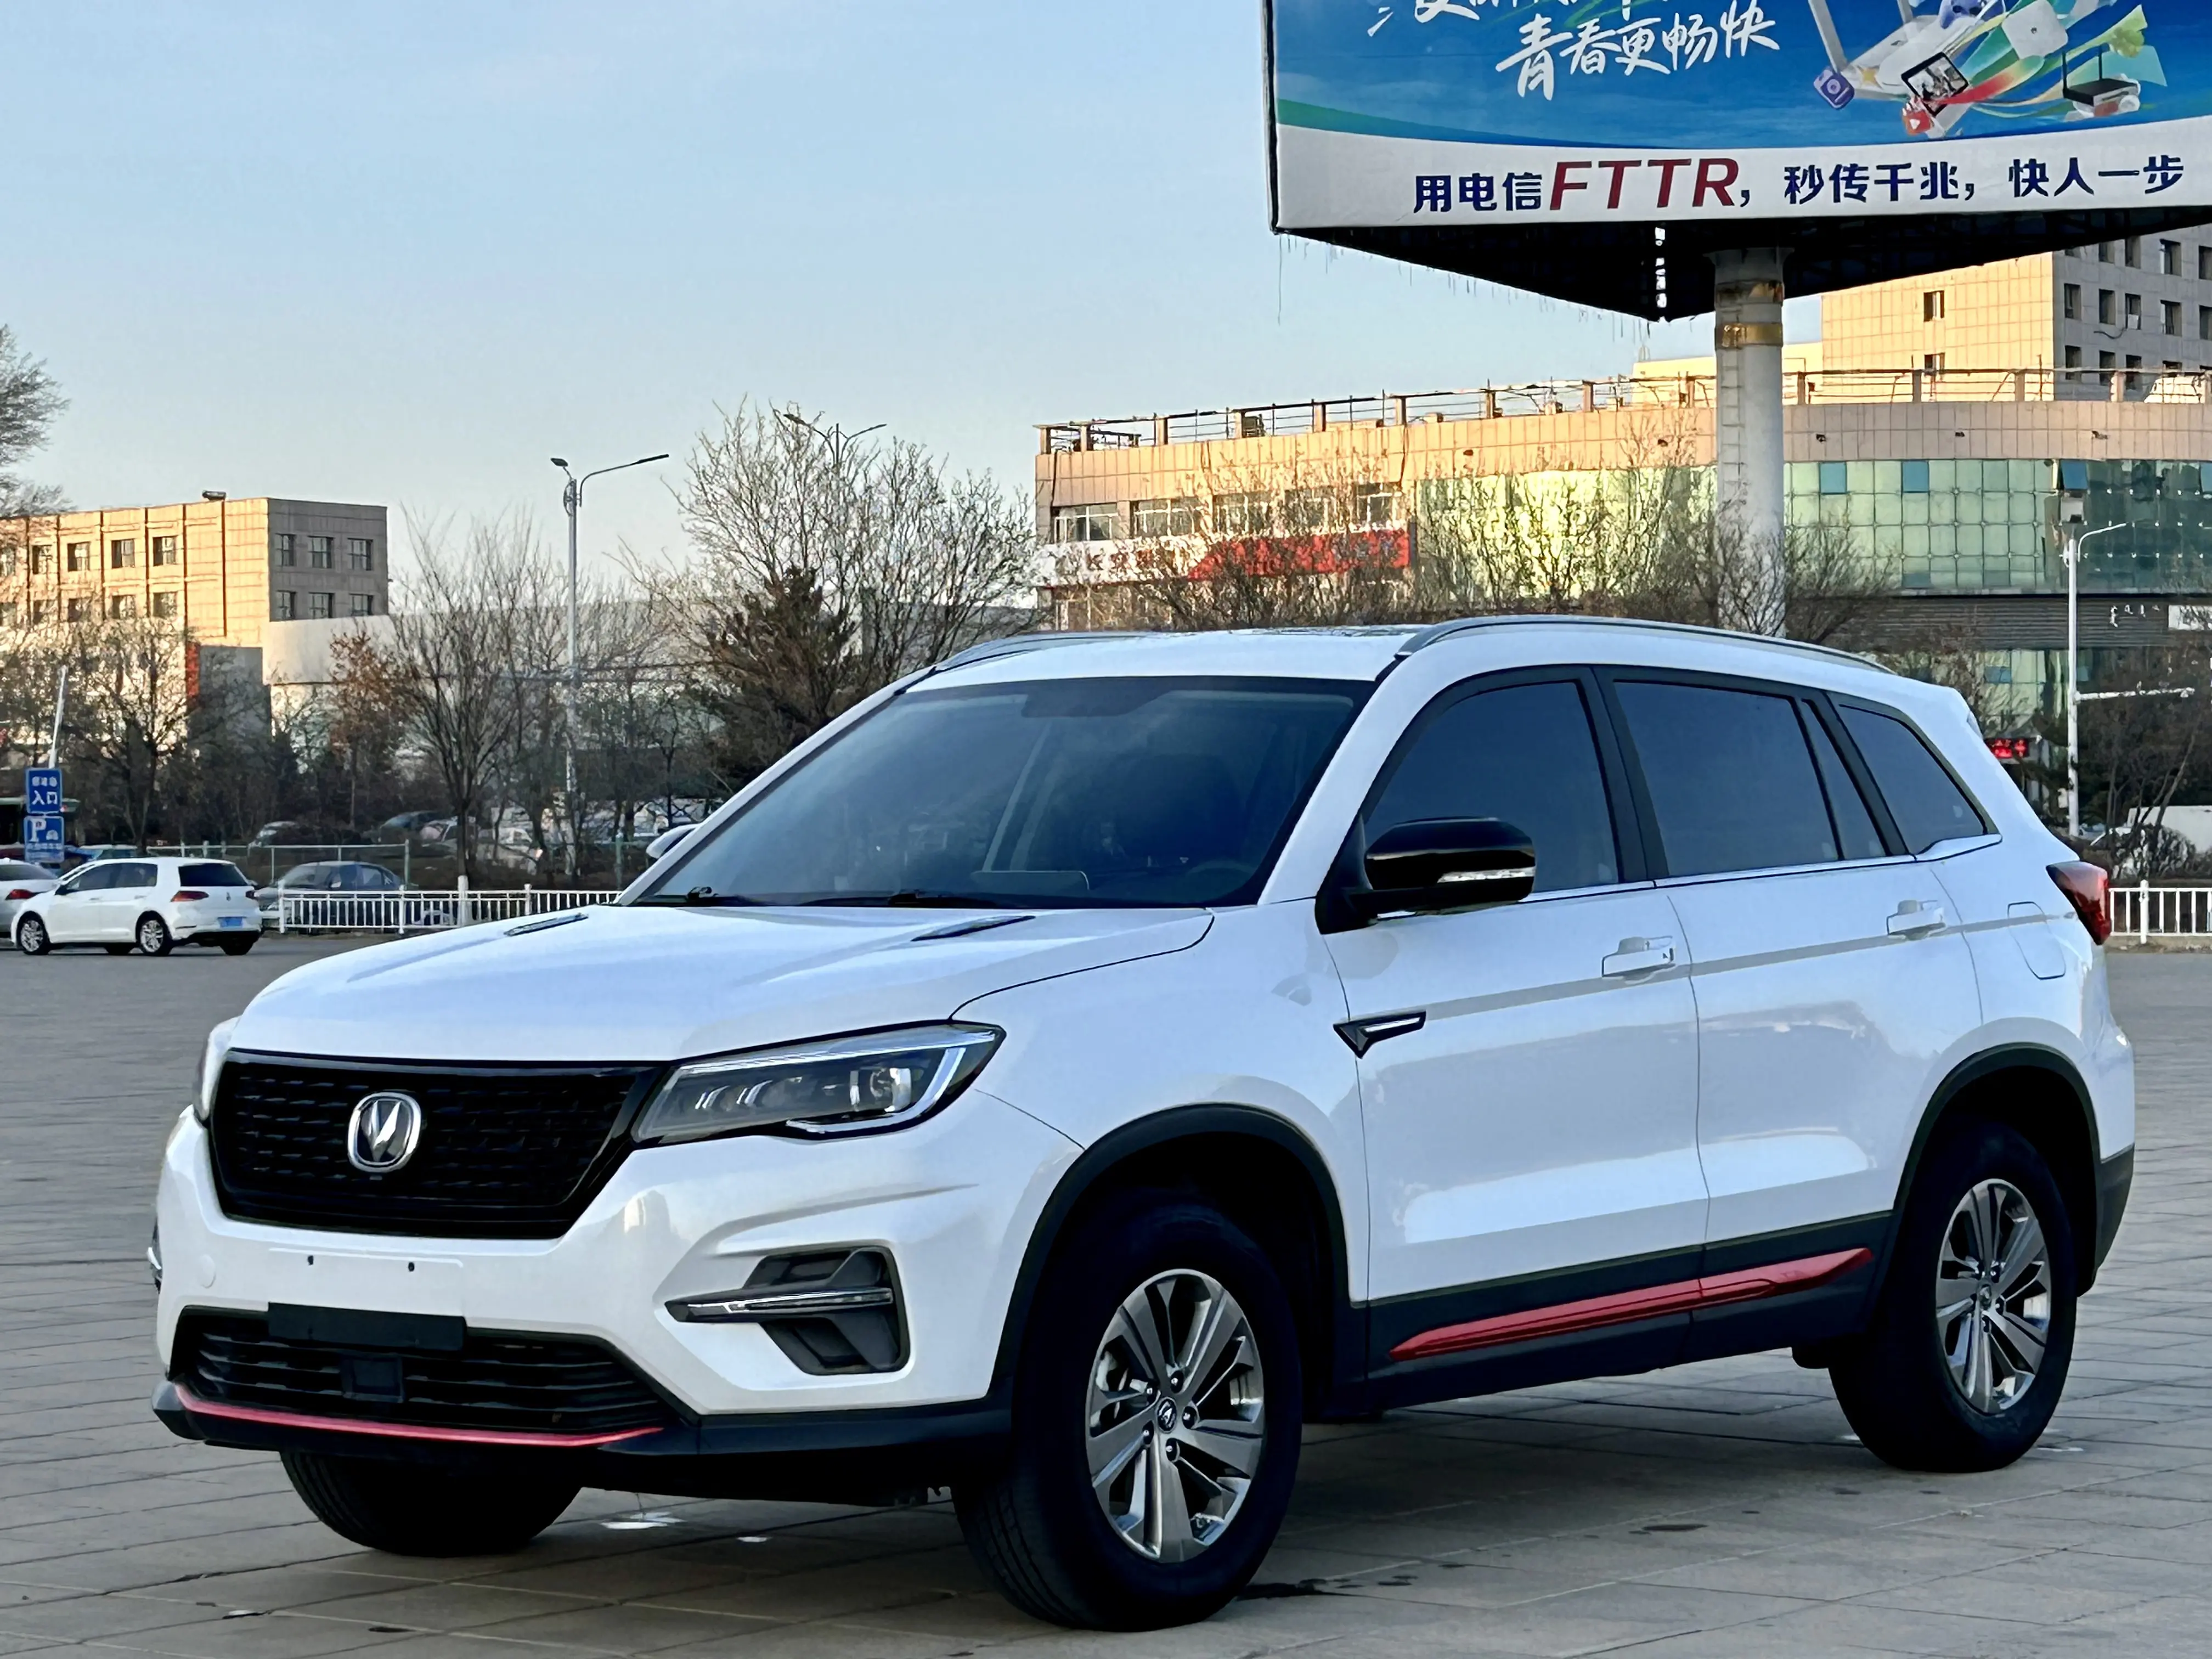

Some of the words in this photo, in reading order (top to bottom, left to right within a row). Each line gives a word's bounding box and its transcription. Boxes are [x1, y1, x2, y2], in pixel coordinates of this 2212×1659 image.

[1496, 0, 1780, 100] 青春更畅快
[32, 790, 58, 805] 入口
[29, 818, 47, 842] P
